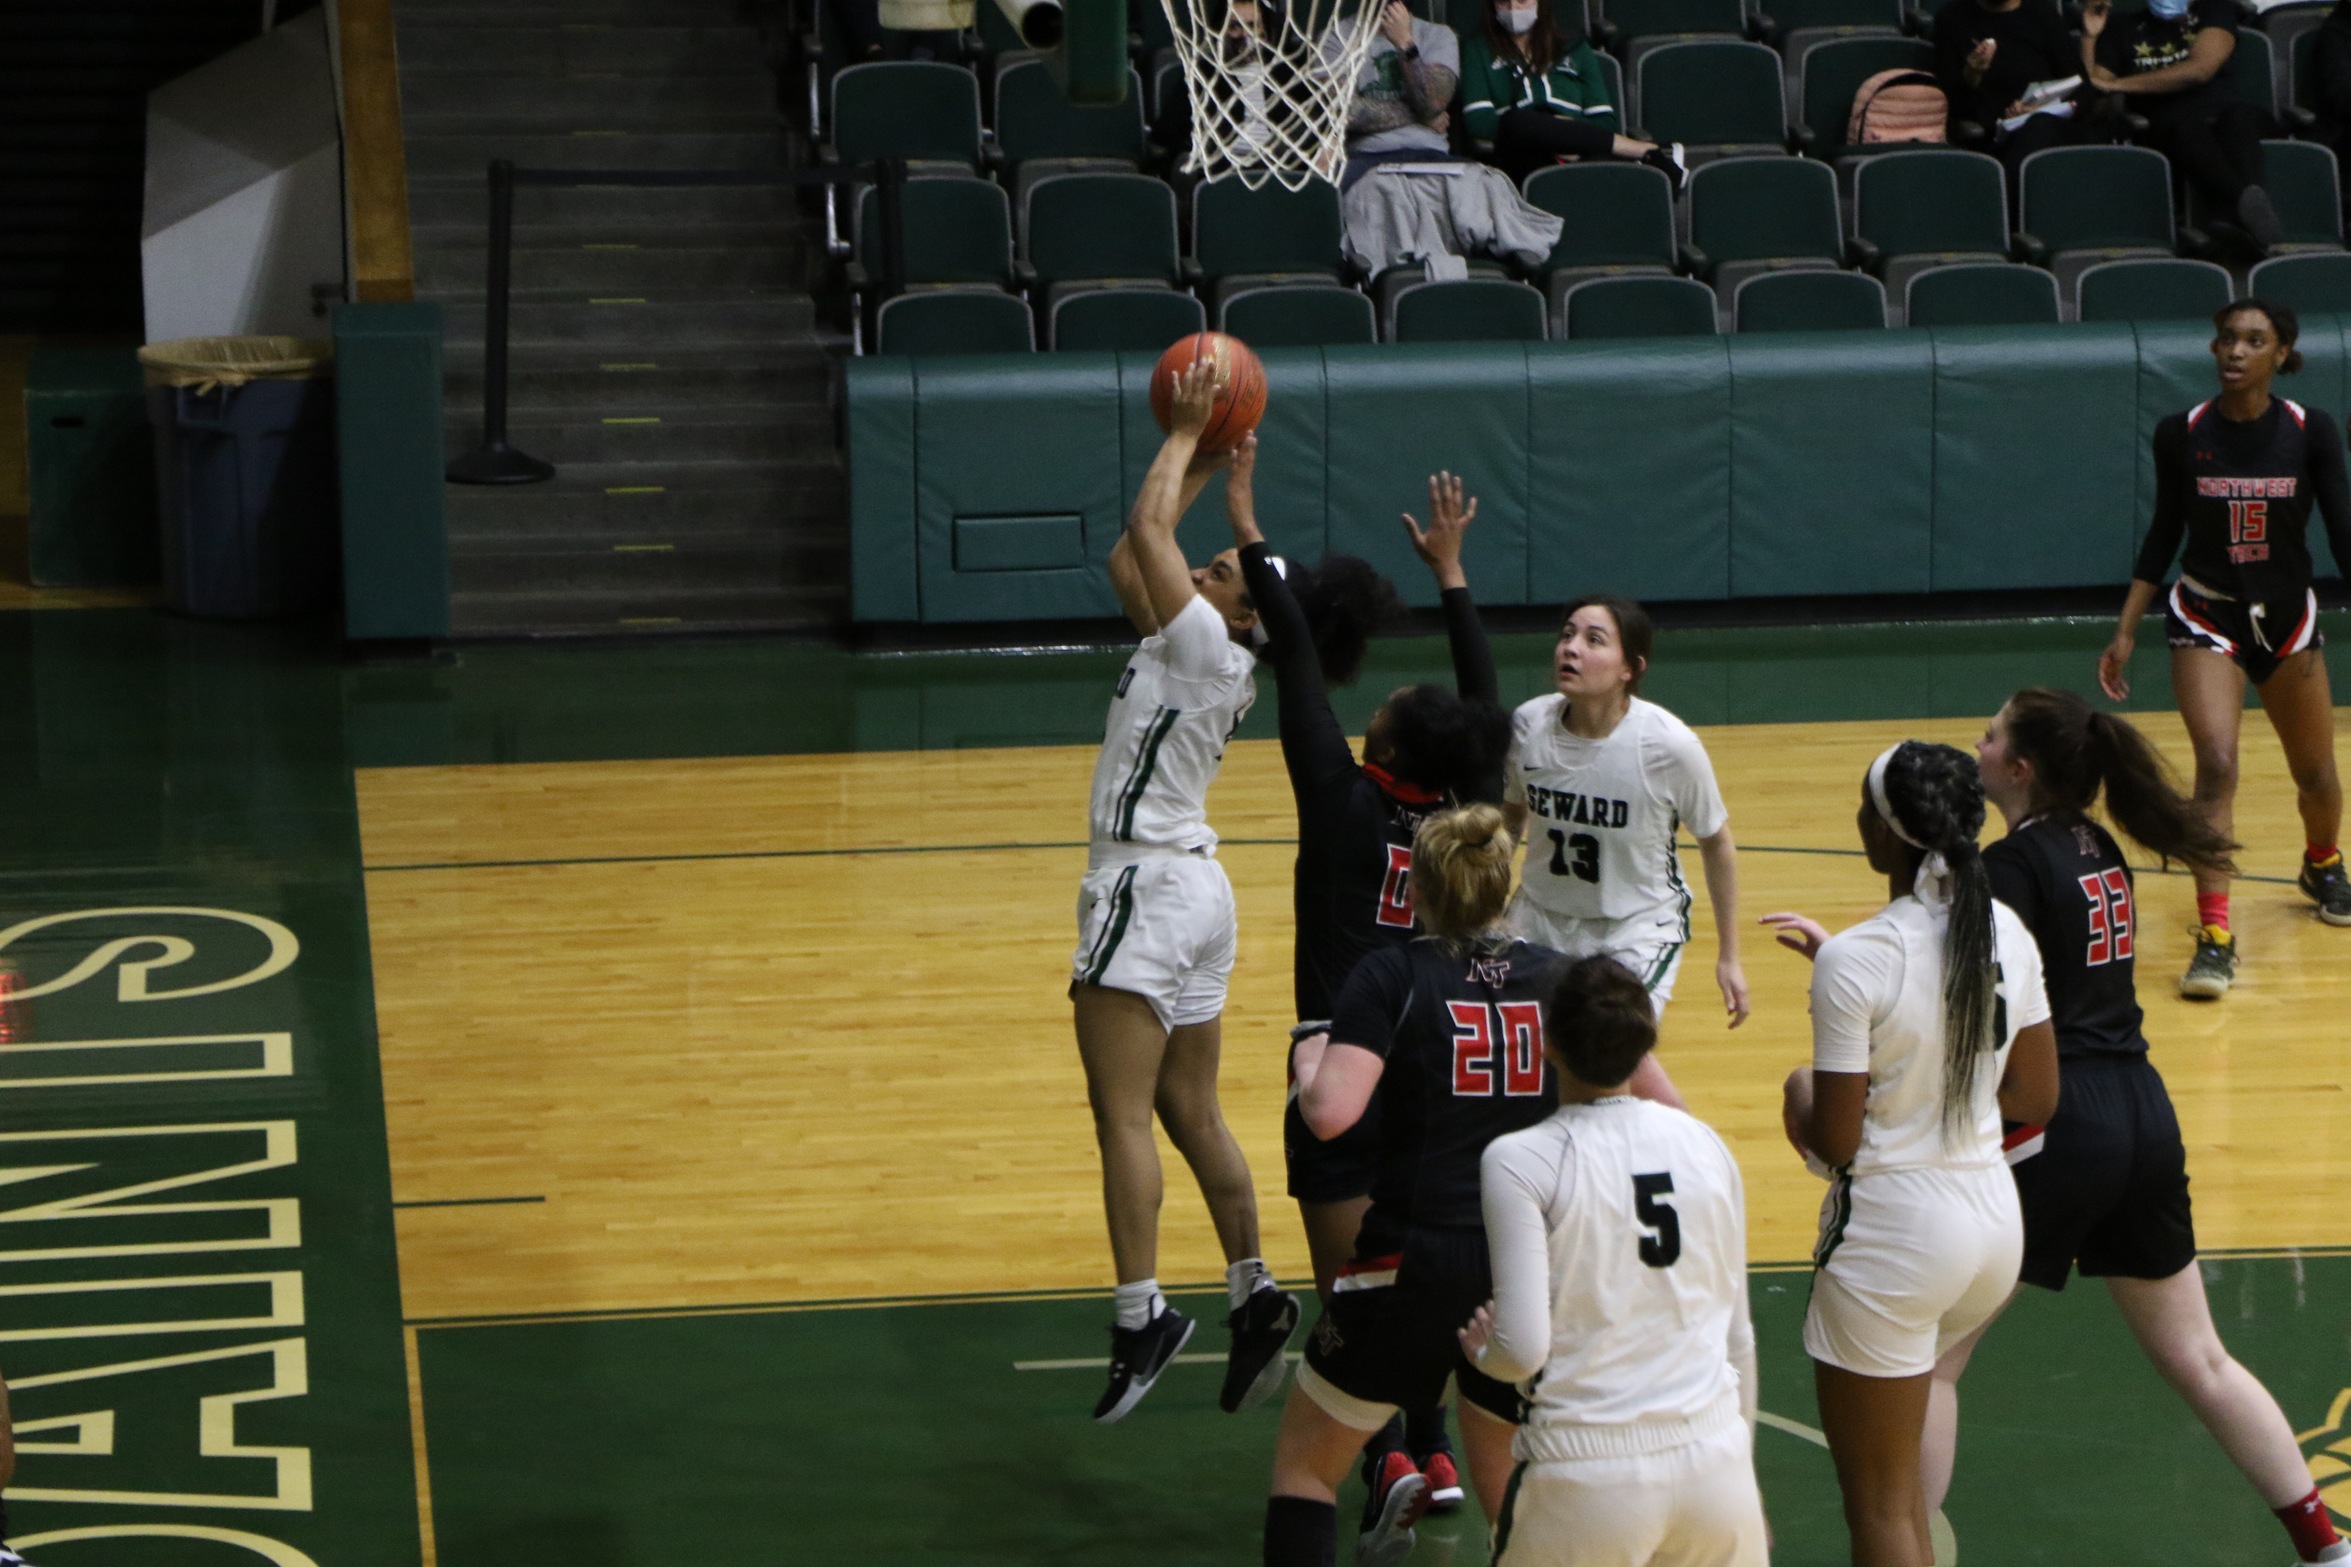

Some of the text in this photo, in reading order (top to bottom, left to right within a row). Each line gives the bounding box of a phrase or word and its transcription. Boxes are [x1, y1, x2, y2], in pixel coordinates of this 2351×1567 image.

[2196, 477, 2297, 498] NORTHWEST
[2227, 500, 2268, 544] 15
[2226, 543, 2270, 564] TECH
[1527, 784, 1629, 828] SEWARD
[1547, 828, 1600, 884] 13
[2078, 866, 2133, 967] 33
[1465, 957, 1511, 989] NT
[1445, 1000, 1544, 1097] 20
[1630, 1171, 1681, 1269] 5
